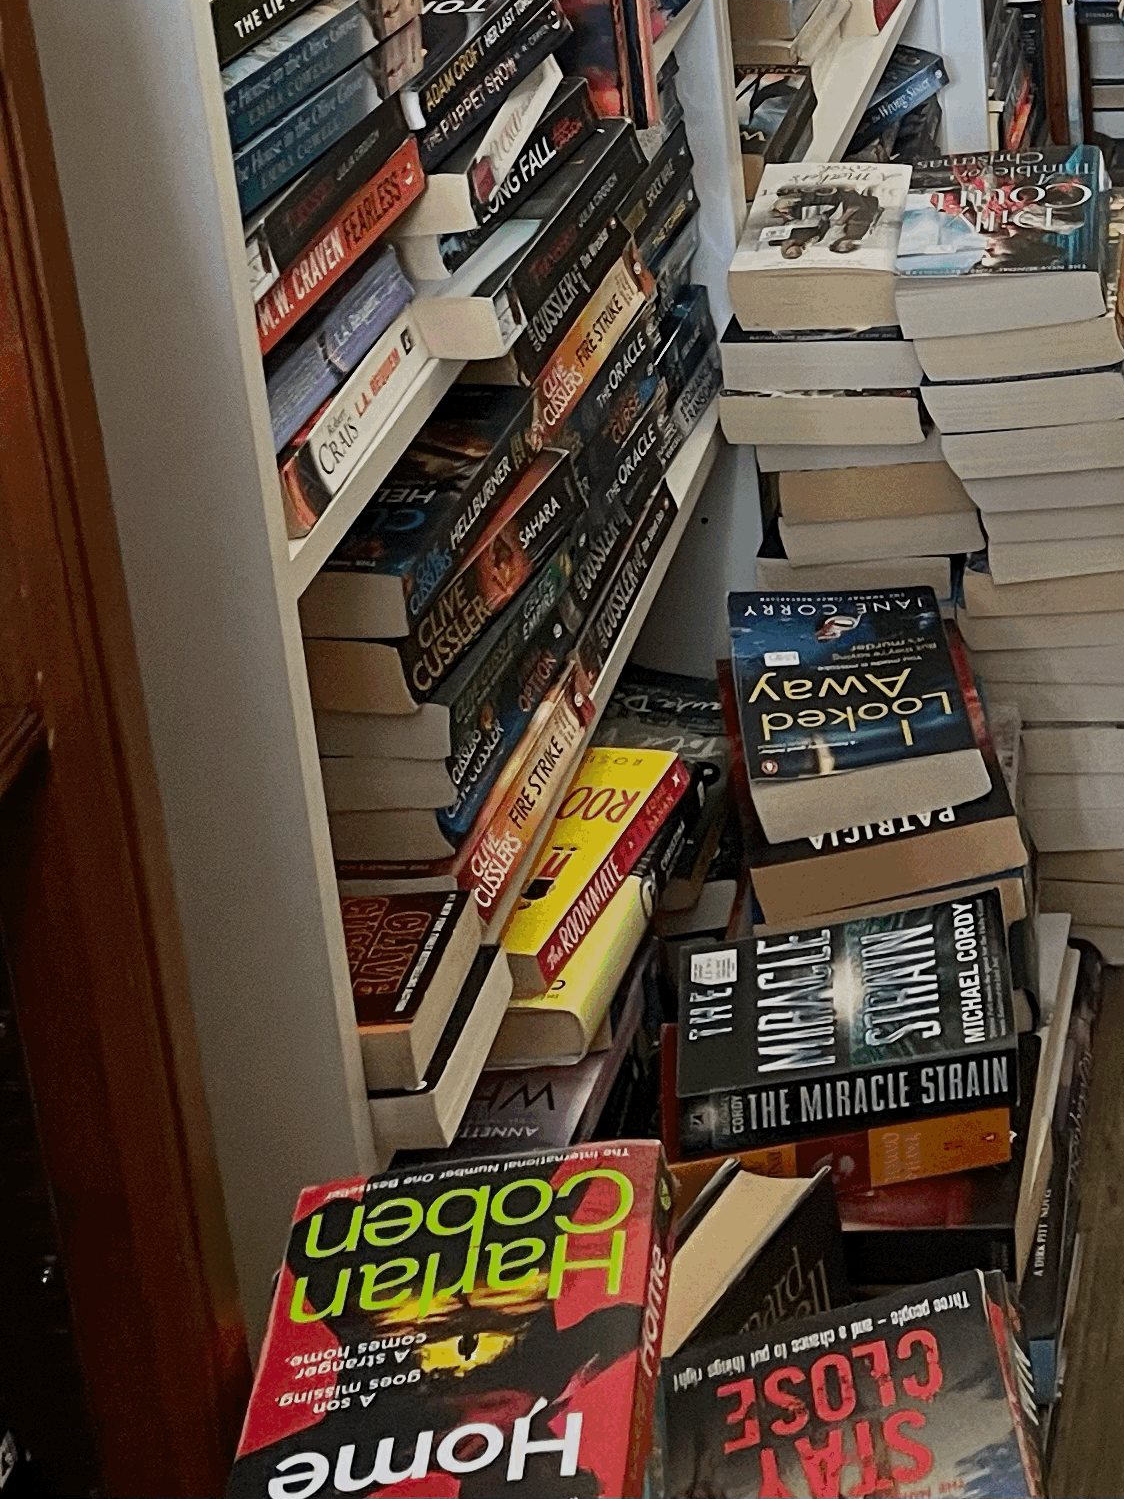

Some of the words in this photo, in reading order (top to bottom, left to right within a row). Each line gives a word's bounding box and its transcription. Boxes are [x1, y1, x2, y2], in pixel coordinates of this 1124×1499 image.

[234, 12, 263, 38] THE
[423, 75, 455, 114] ADAM
[451, 35, 485, 82] CROFT
[439, 83, 486, 140] PUPPET
[482, 58, 520, 96] SHOW
[519, 137, 557, 185] FALL
[918, 151, 1044, 169] Christmas
[936, 182, 1093, 209] Court
[292, 225, 345, 300] CRAVEN
[341, 169, 403, 251] FEARLESS
[576, 332, 598, 368] FIRE
[592, 292, 624, 342] STRIKE
[608, 331, 648, 391] ORACLE
[318, 422, 360, 478] CRAIS
[617, 423, 658, 487] ORACLE
[449, 455, 512, 551] HELLBURNER
[519, 496, 562, 550] SAHARA
[418, 578, 466, 649] CLIVE
[744, 603, 838, 617] CORRY
[855, 597, 923, 615] JANE
[412, 596, 493, 692] CUSSLER
[749, 667, 913, 704] Away
[763, 691, 952, 741] Looked
[901, 719, 914, 746] I
[508, 783, 532, 830] FIRE
[528, 734, 564, 795] STRIKE
[470, 832, 500, 879] CLIVE
[559, 853, 625, 951] ROOMMATE
[951, 899, 978, 963] CORDY
[689, 985, 734, 1041] THE
[757, 929, 837, 1074] MIRACLE
[859, 924, 942, 1047] STRAIN
[959, 963, 987, 1044] MICHAEL
[748, 1089, 792, 1130] THE
[799, 1069, 911, 1124] MIRACLE
[920, 1055, 1009, 1105] STRAIN
[502, 1150, 598, 1173] International
[601, 1147, 630, 1158] The
[402, 1172, 435, 1184] One
[439, 1163, 499, 1181] Number
[304, 1168, 635, 1258] Coben
[289, 1229, 626, 1323] Harlan
[891, 1301, 933, 1327] people
[931, 1291, 970, 1313] Three
[357, 1332, 428, 1351] comes
[792, 1328, 837, 1353] chance
[838, 1326, 848, 1339] a
[849, 1317, 874, 1340] and
[284, 1344, 351, 1368] home.
[394, 1349, 411, 1362] A
[750, 1346, 771, 1371] put
[773, 1340, 788, 1359] to
[294, 1352, 387, 1380] stranger
[672, 1366, 704, 1394] right
[707, 1351, 746, 1380] things
[273, 1378, 363, 1409] missing.
[368, 1370, 422, 1392] goes
[716, 1329, 943, 1455] CLOSE
[311, 1396, 351, 1415] son
[358, 1395, 377, 1409] A
[266, 1397, 584, 1499] Home
